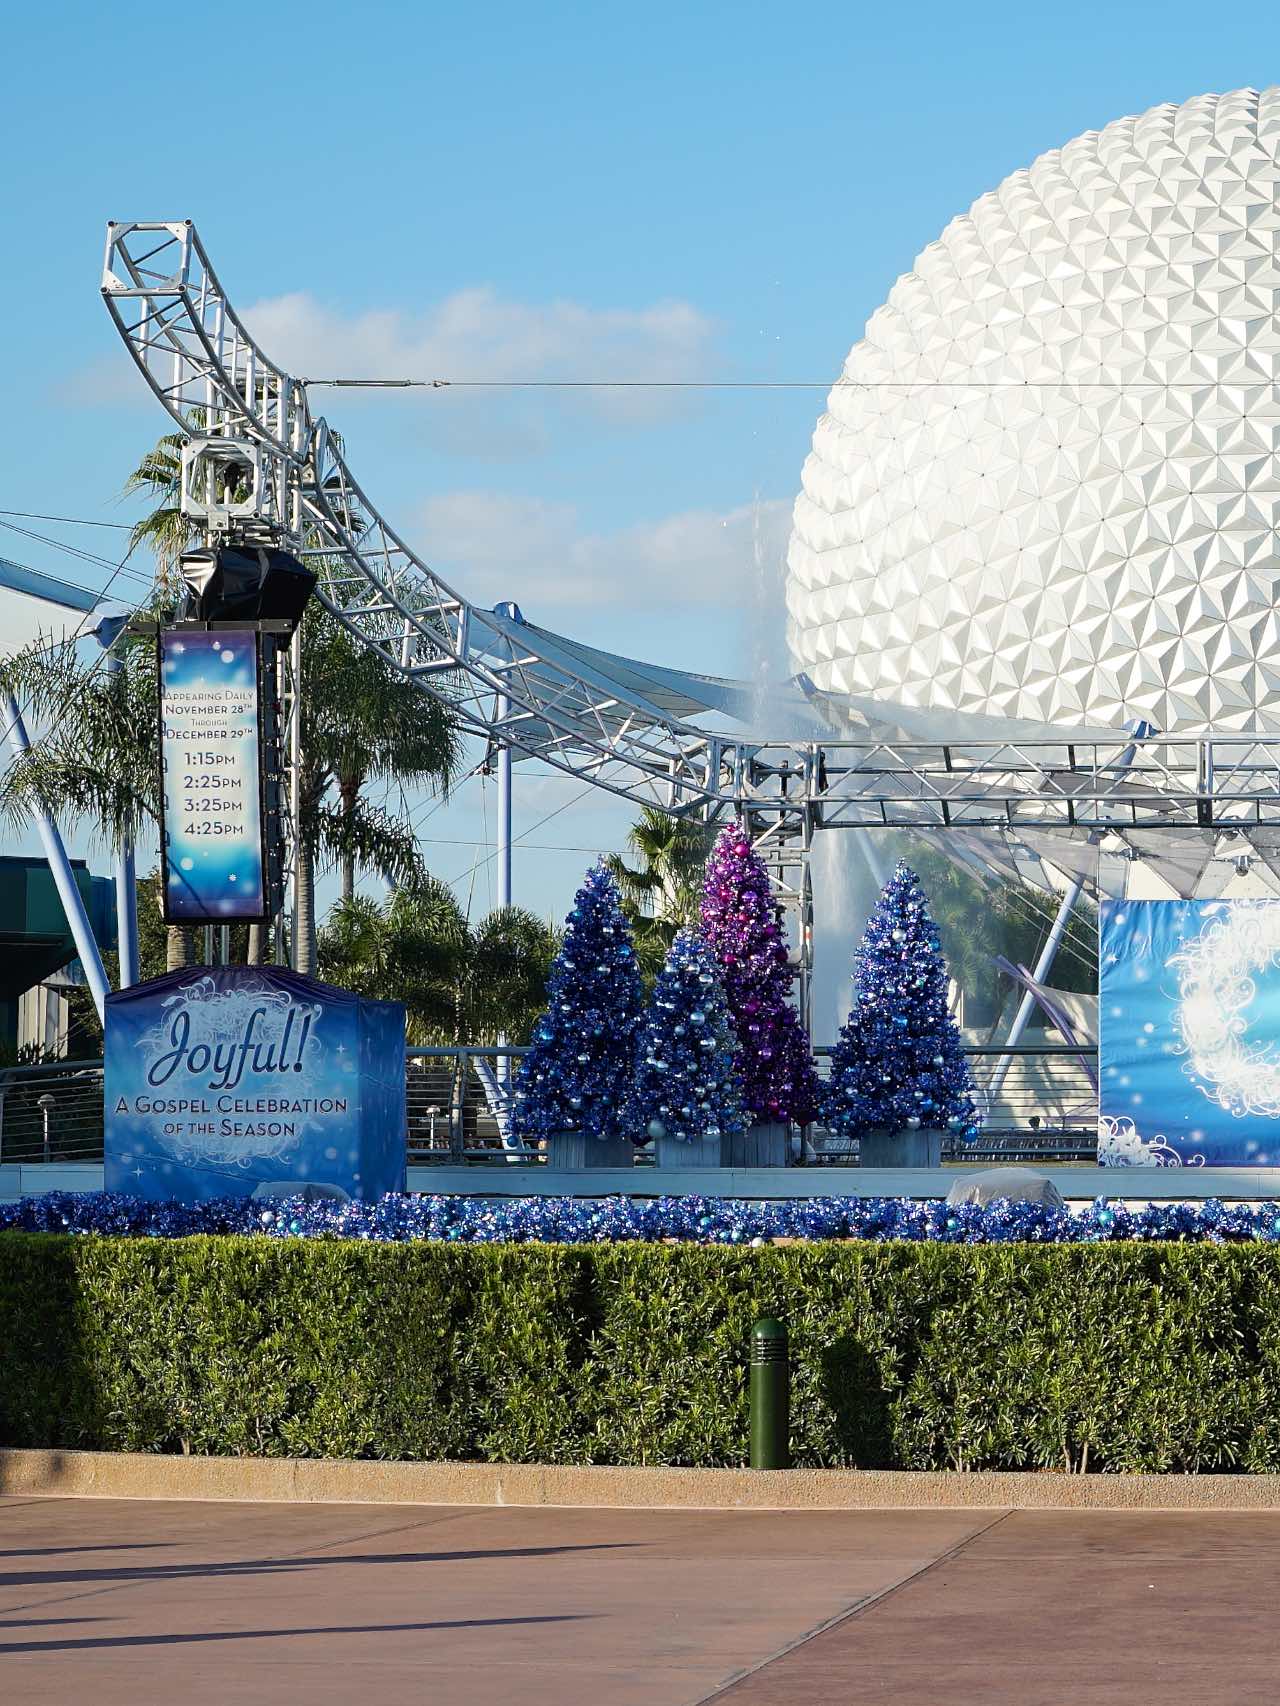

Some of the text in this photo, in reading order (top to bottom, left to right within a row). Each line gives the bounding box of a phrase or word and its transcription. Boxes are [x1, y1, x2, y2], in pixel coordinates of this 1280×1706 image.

[225, 690, 254, 701] DAILY
[165, 704, 228, 715] NOVEMBER
[166, 729, 227, 740] DECEMBER
[184, 752, 235, 765] 1:15PM
[184, 776, 241, 789] 2:25PM
[184, 799, 242, 812] 3:25PM
[184, 822, 243, 835] 4:25PM
[147, 1006, 312, 1090] Joyful!
[115, 1095, 347, 1114] A GOSPEL CELEBRATION
[221, 1118, 295, 1137] SEASON
